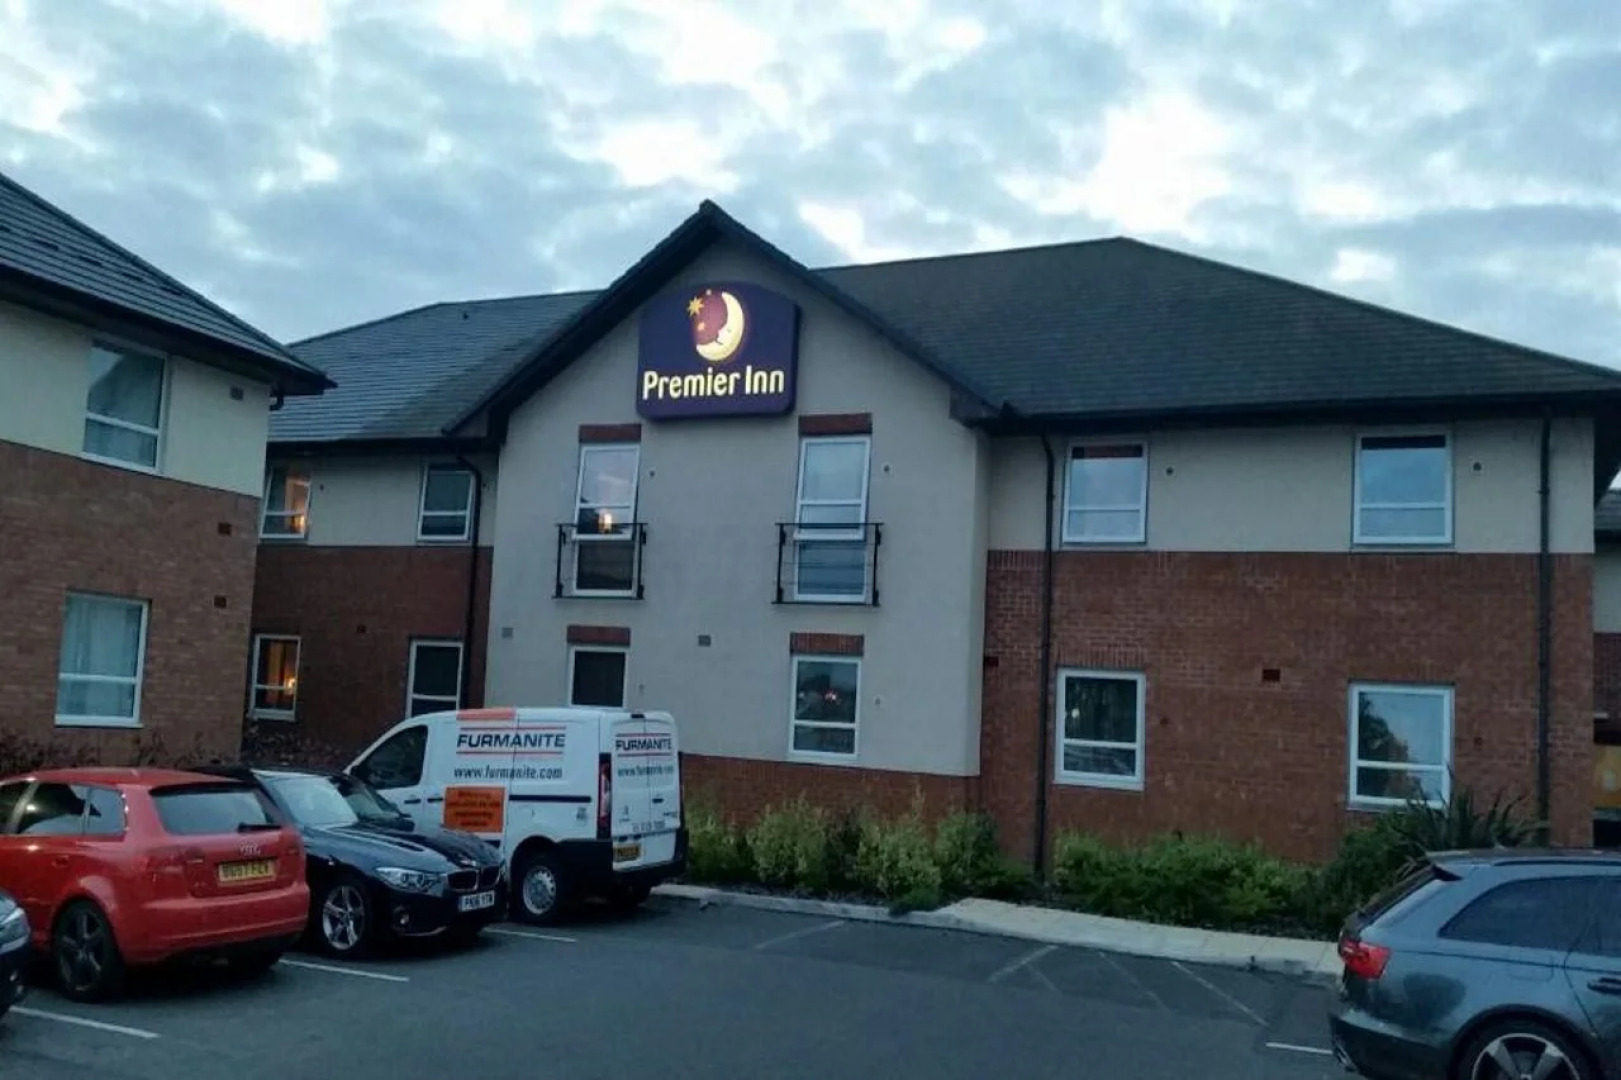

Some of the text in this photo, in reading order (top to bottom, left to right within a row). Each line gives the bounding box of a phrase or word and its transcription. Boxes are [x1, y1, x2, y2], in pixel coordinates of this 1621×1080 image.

[642, 365, 785, 400] Premier Inn
[456, 733, 566, 748] FURMANITE
[615, 738, 671, 750] FURMANITE
[453, 765, 563, 779] www.furmanite.com
